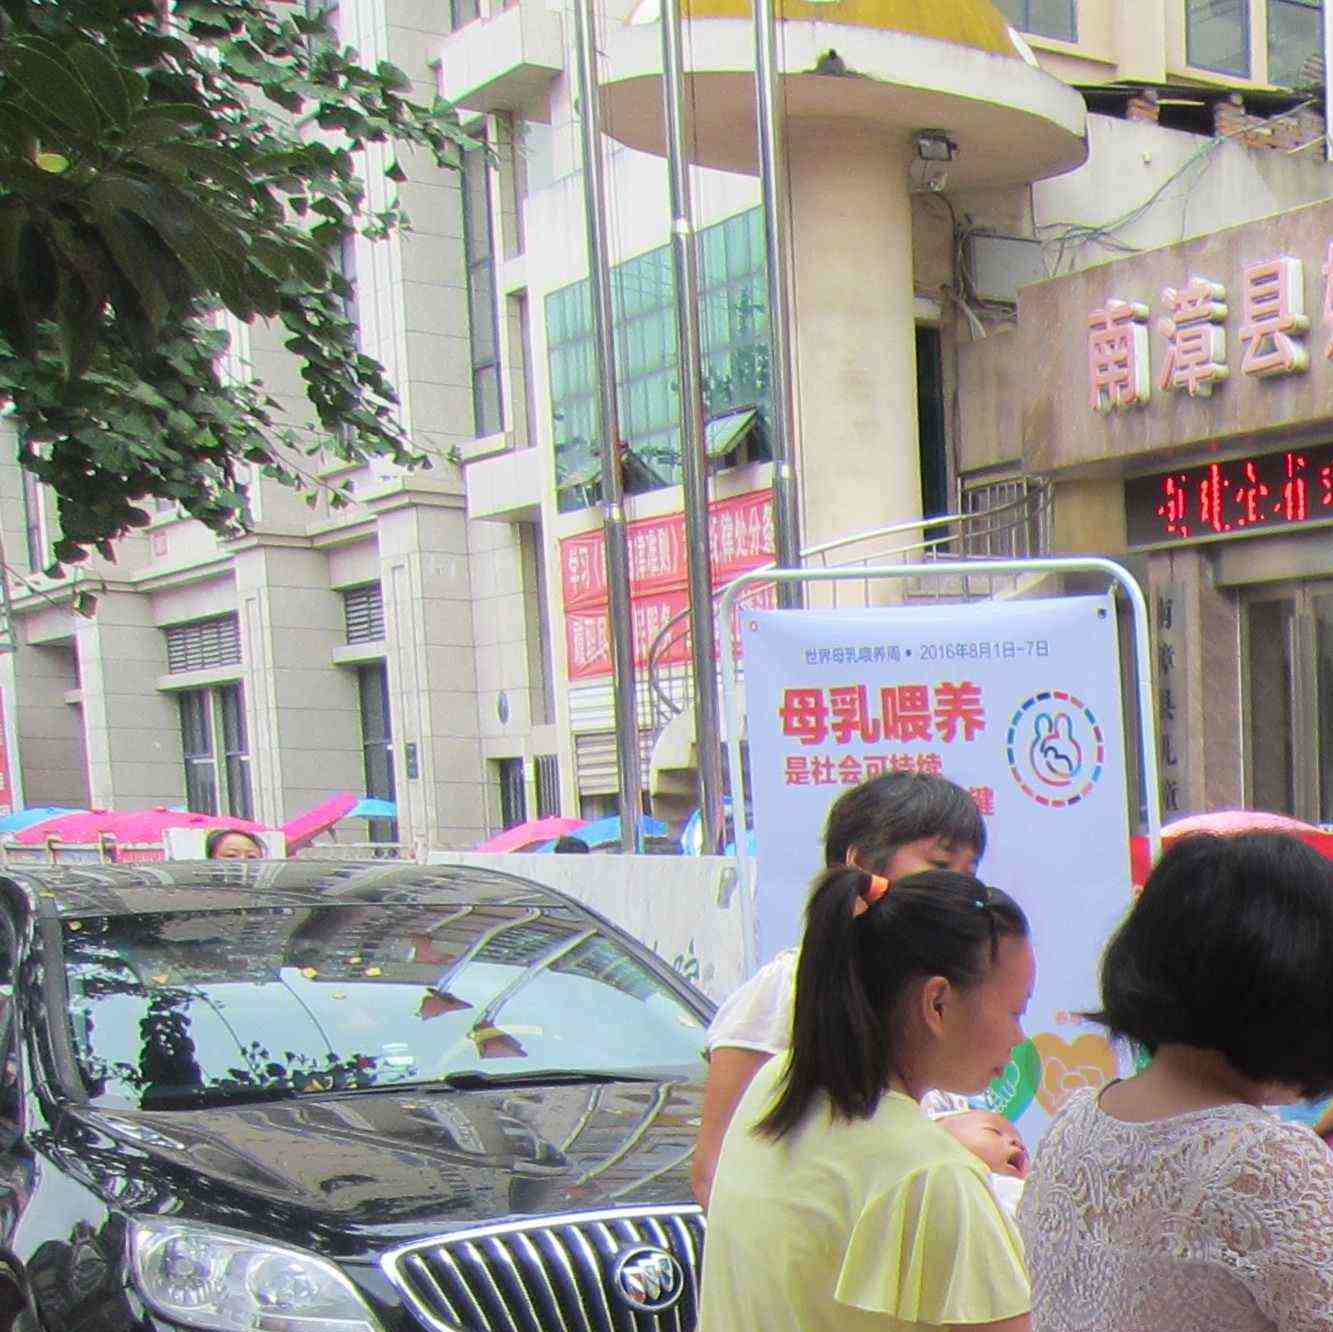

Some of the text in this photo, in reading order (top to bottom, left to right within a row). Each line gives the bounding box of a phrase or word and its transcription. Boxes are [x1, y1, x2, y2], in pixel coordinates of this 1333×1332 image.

[919, 639, 1049, 662] 2016年8月1日-7日
[779, 681, 987, 746] 母乳喂养
